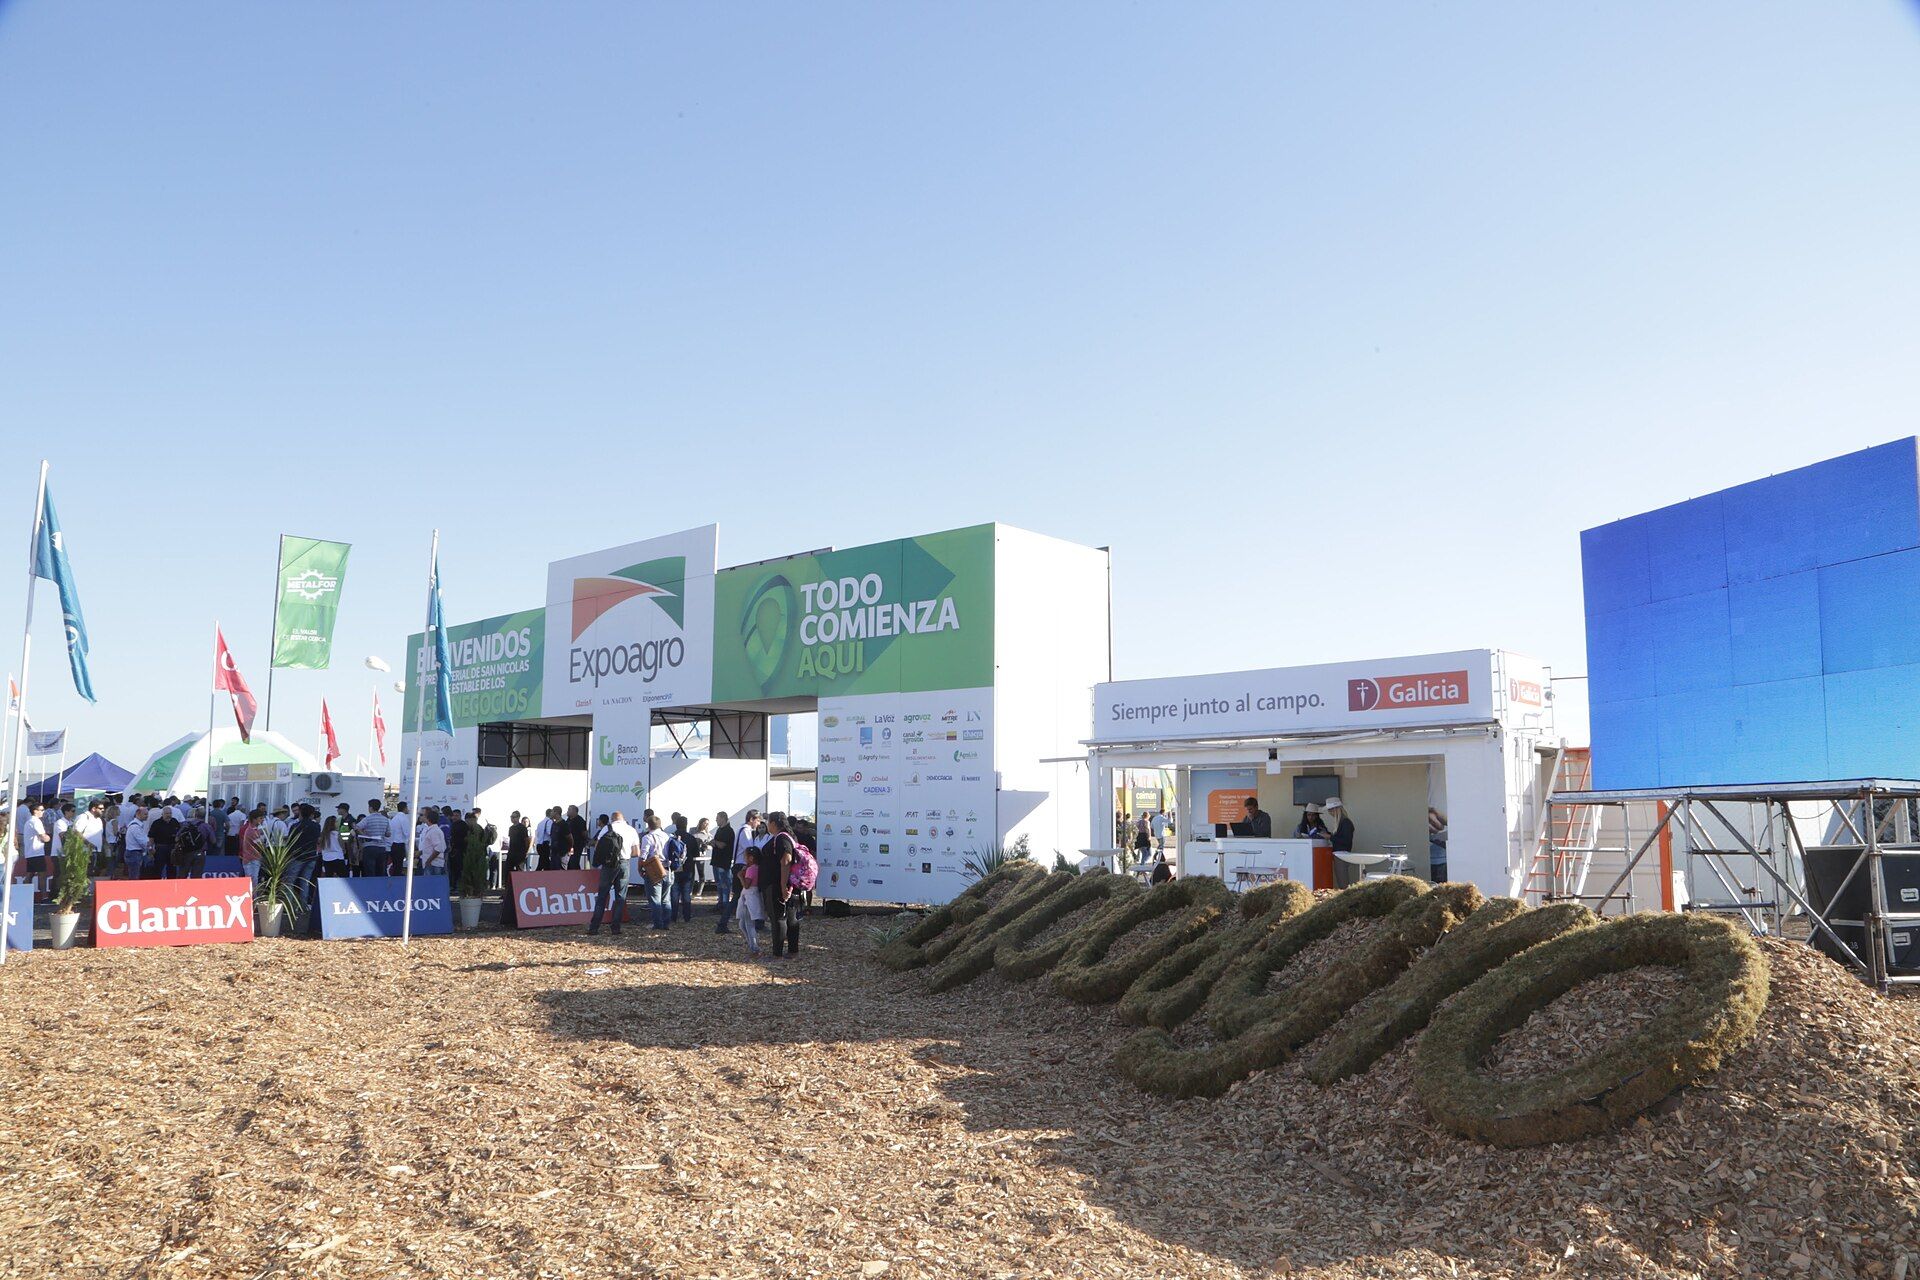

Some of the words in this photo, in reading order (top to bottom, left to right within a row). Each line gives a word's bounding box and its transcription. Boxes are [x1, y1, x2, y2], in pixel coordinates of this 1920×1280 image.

[287, 580, 336, 589] METALFOR
[800, 573, 883, 613] TODO
[800, 597, 960, 646] COMIENZA
[417, 627, 531, 673] BIEVENIDOS
[471, 666, 481, 679] DE
[481, 664, 496, 678] SAN
[497, 660, 529, 675] NICOLAS
[570, 637, 684, 688] Expoagro
[452, 679, 480, 694] ESTABLE
[480, 678, 490, 690] DE
[491, 676, 505, 689] LOS
[1388, 679, 1459, 703] Galicia
[415, 688, 528, 721] GNEGOCIOS
[1112, 702, 1178, 724] Siempre
[1183, 698, 1230, 722] junto
[1236, 693, 1250, 712] al
[1256, 693, 1325, 715] campo.
[903, 713, 932, 724] agrovoz
[617, 744, 638, 754] Banco
[617, 755, 646, 766] Provincia
[595, 782, 630, 795] Procampo
[97, 896, 227, 935] Clarín
[332, 901, 361, 915] LA
[366, 898, 441, 914] NACON
